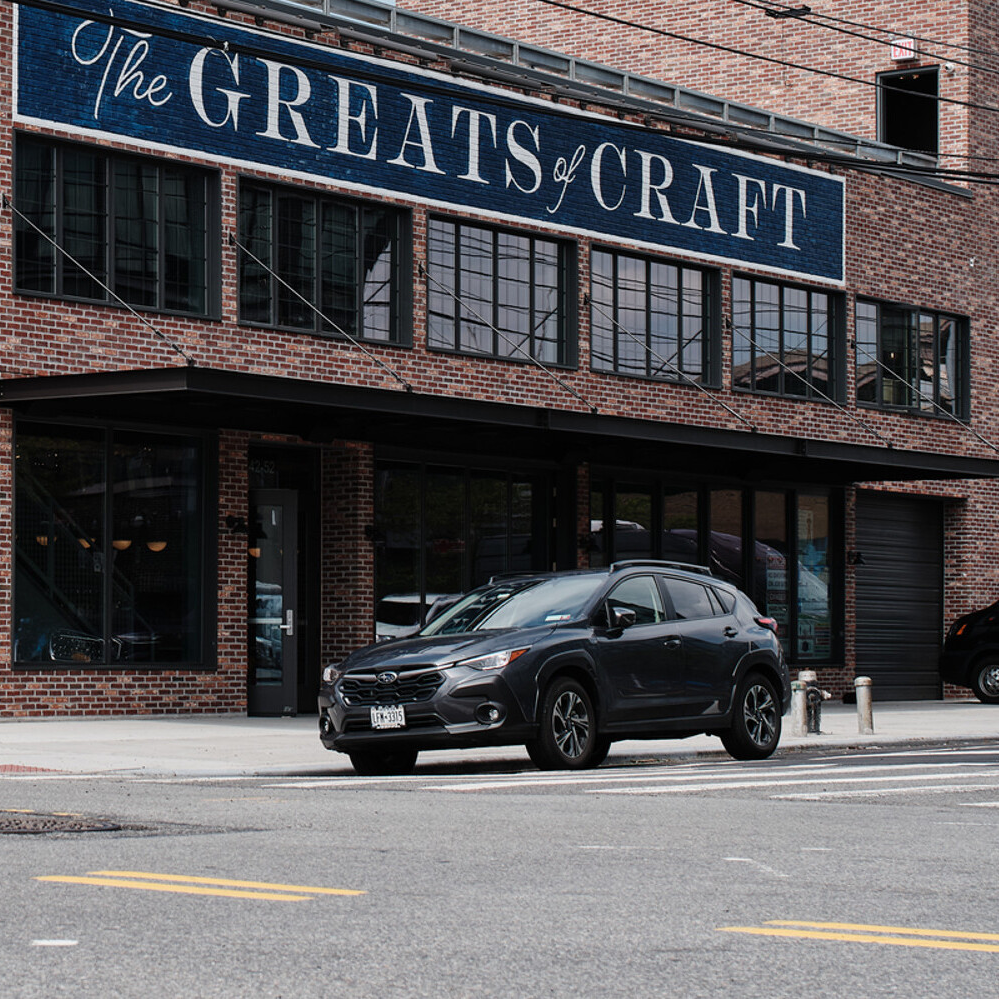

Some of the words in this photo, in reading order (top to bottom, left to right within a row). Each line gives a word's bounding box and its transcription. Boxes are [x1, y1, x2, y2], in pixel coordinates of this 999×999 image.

[893, 40, 913, 59] EXIT
[71, 8, 173, 120] The
[188, 45, 543, 195] GREATS
[546, 144, 586, 214] of
[590, 141, 807, 251] CRAFT
